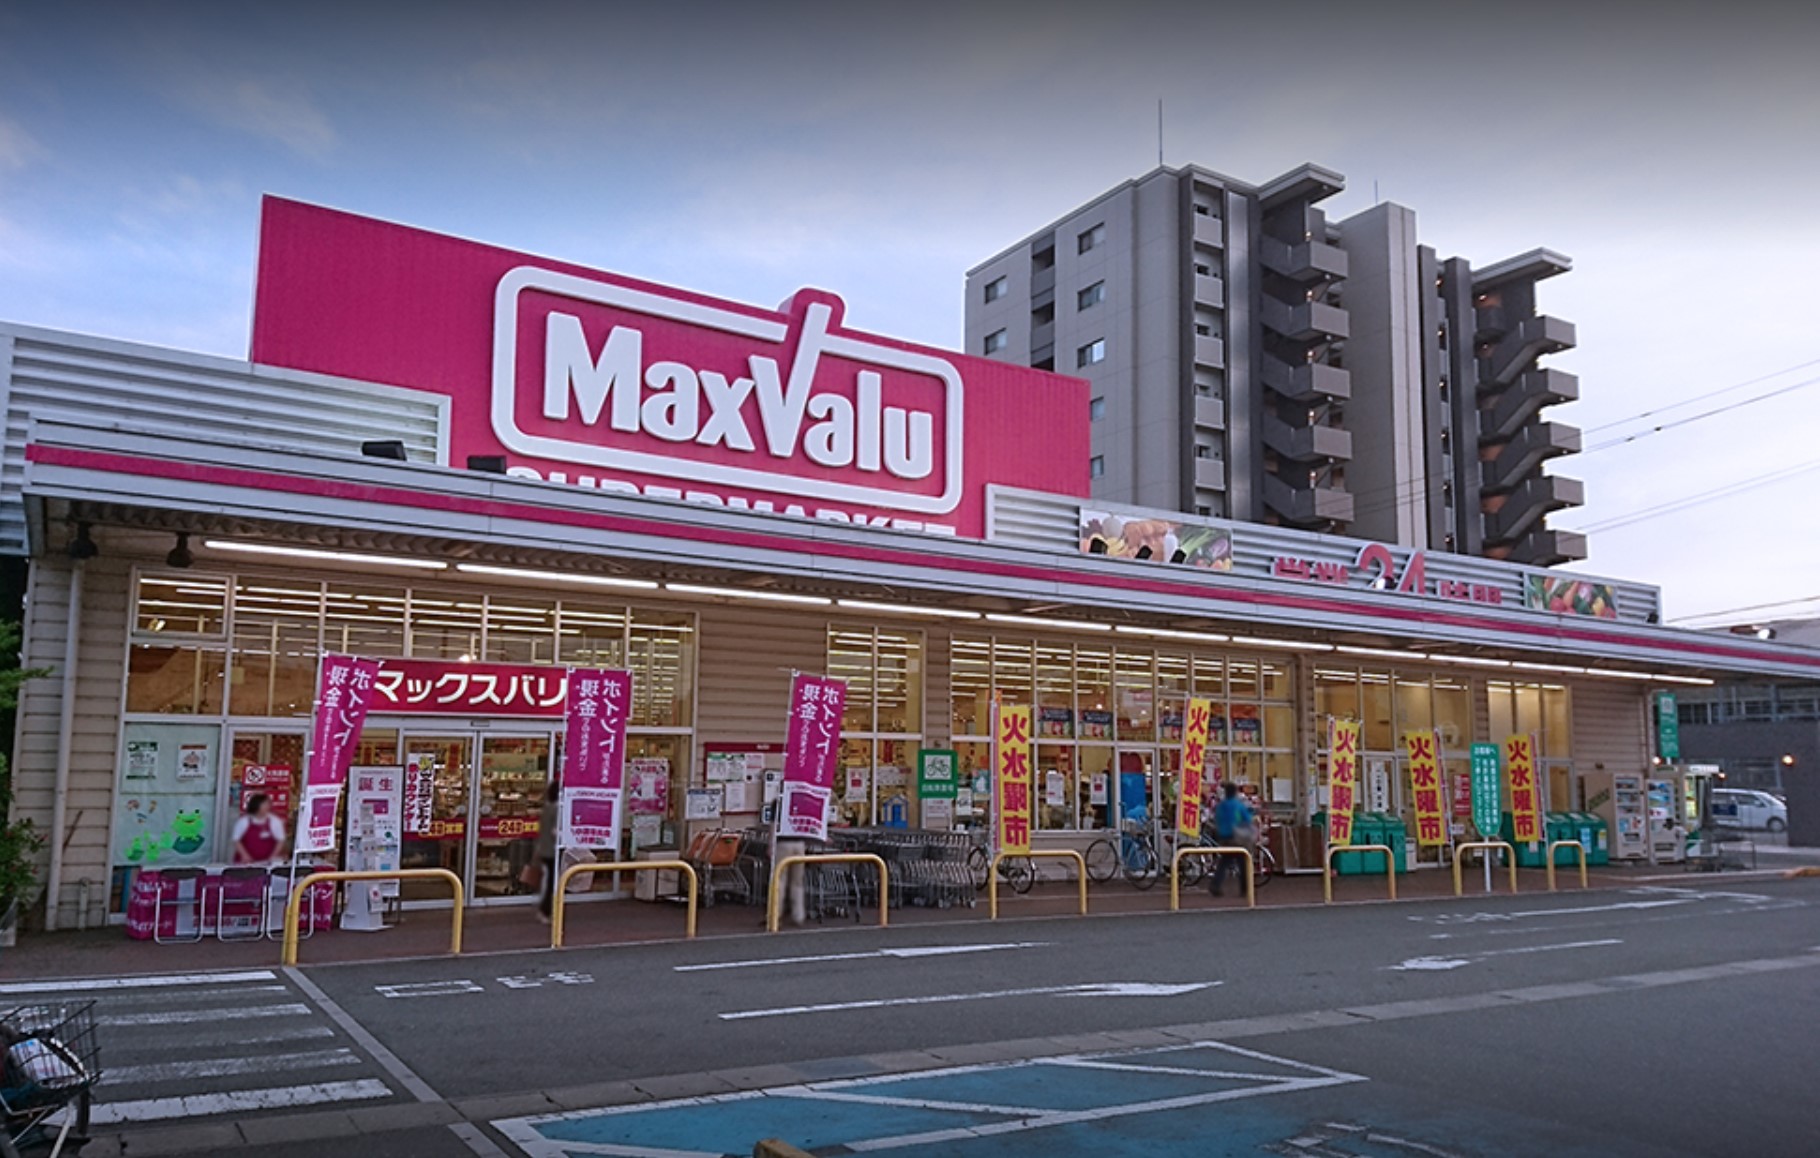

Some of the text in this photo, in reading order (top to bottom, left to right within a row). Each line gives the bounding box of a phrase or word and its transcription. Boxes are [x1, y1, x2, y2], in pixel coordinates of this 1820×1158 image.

[543, 302, 933, 479] MaxValu
[1409, 736, 1440, 840] 火水曜市
[1507, 740, 1534, 836] 火水曜市
